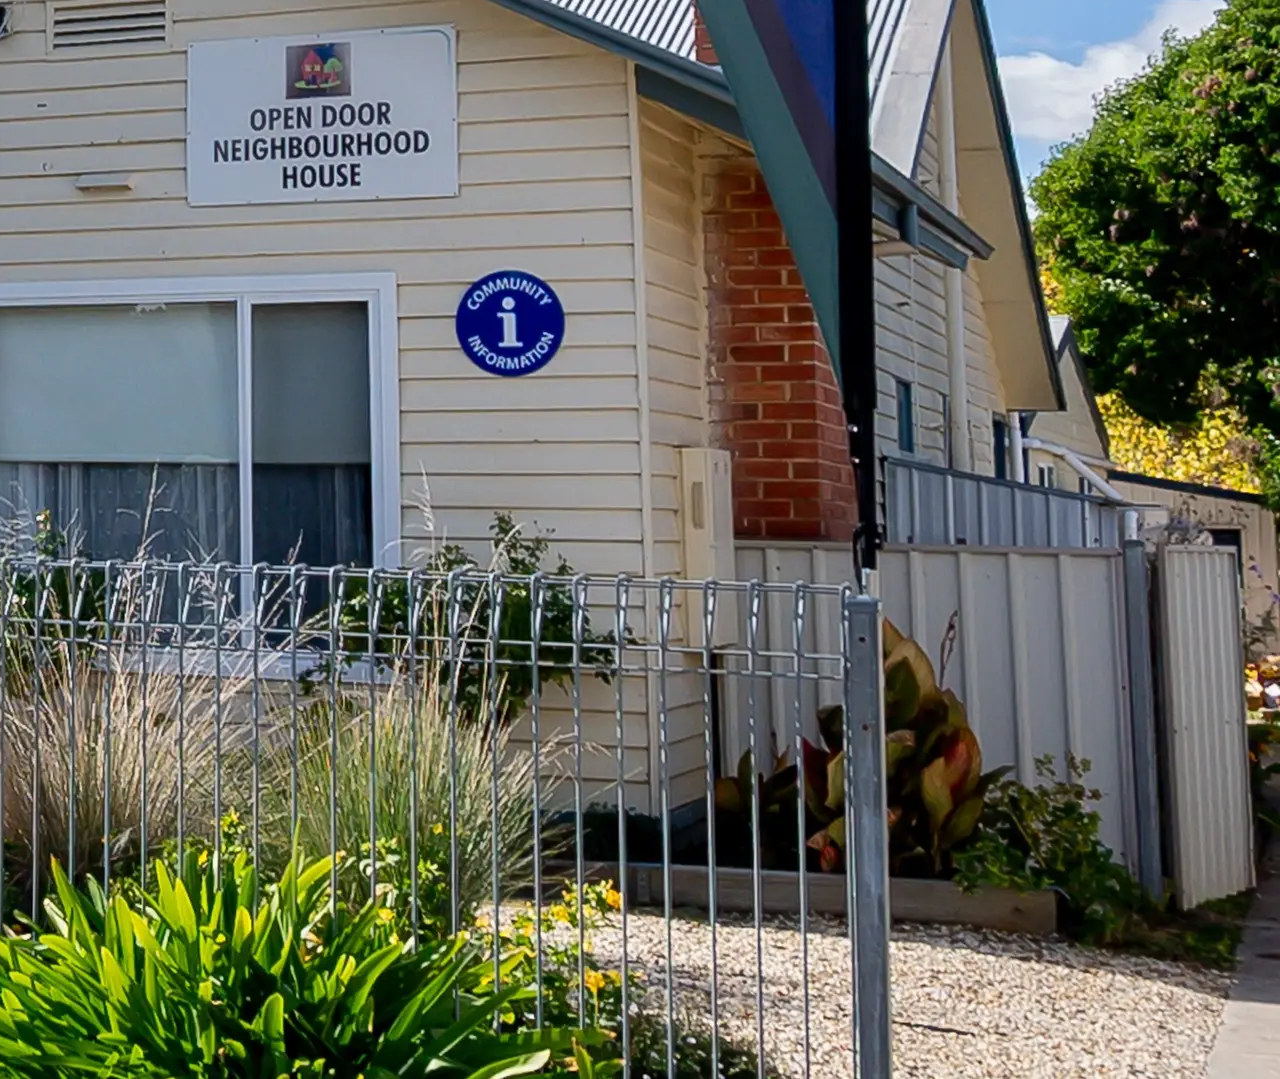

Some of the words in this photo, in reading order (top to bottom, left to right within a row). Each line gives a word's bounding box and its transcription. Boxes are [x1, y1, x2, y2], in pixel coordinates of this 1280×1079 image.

[249, 105, 312, 131] OPEN
[321, 102, 392, 128] DOOR
[213, 130, 430, 163] NEIGHBOURHOOD
[282, 163, 362, 189] HOUSE
[467, 277, 552, 310] COMMUNITY
[467, 331, 555, 369] INFORMATION
